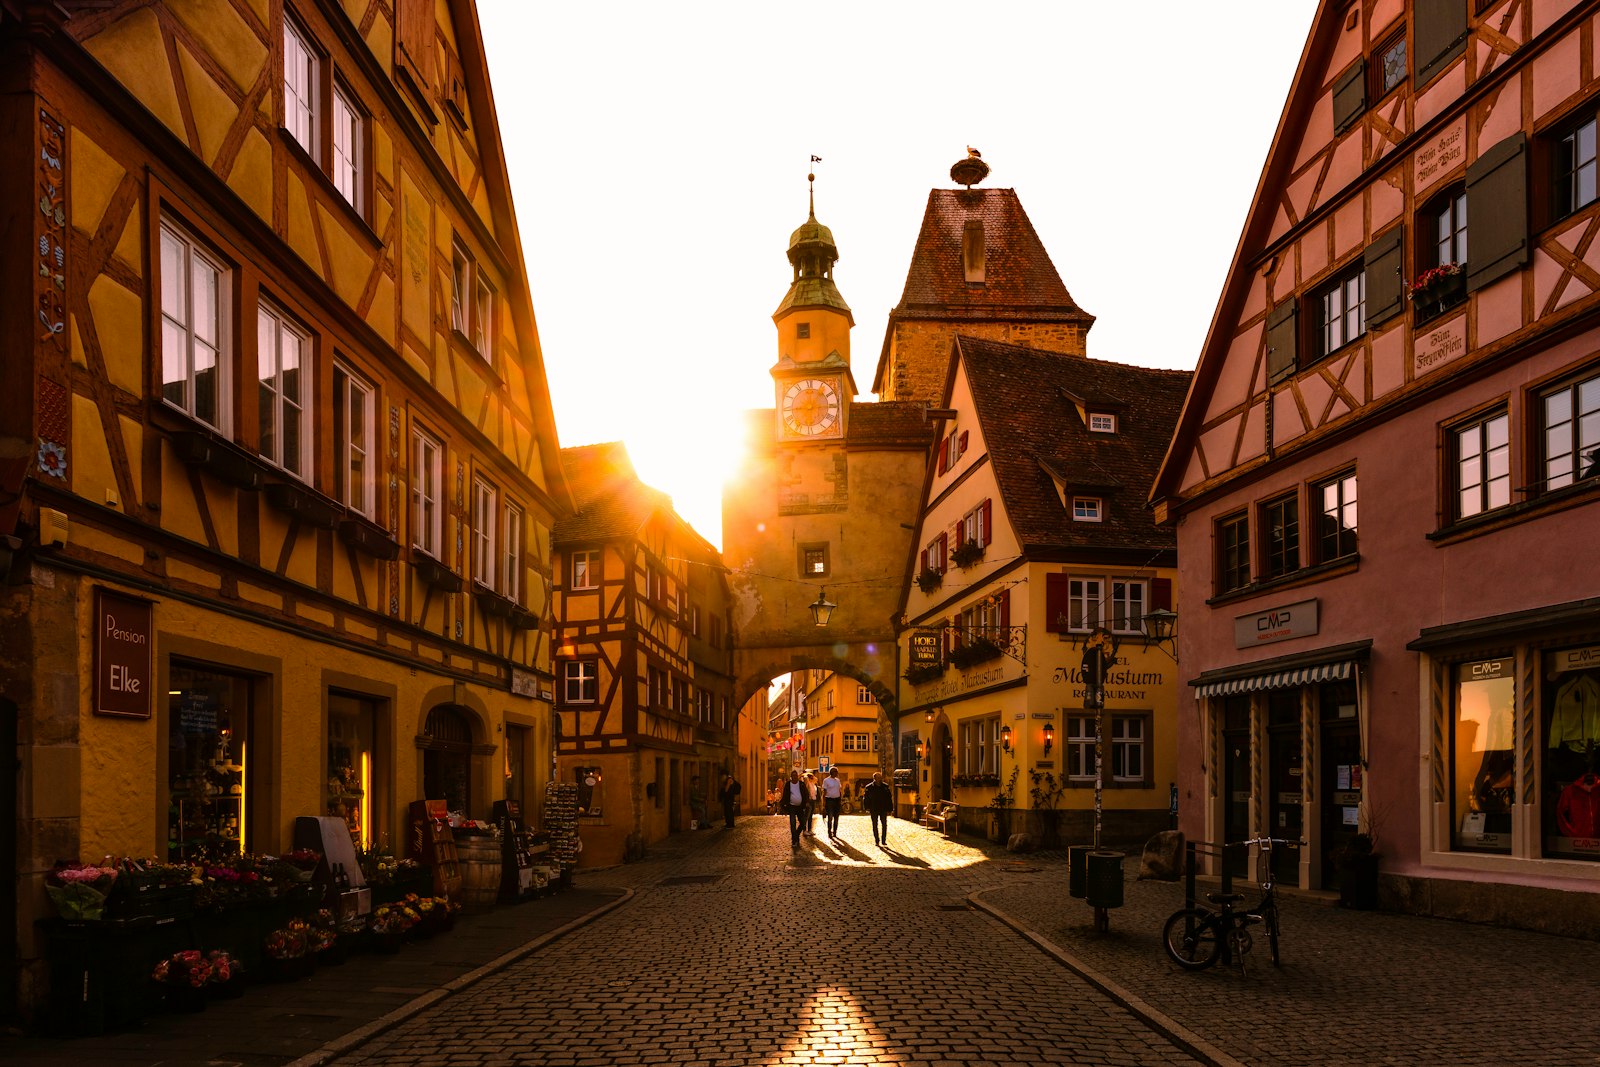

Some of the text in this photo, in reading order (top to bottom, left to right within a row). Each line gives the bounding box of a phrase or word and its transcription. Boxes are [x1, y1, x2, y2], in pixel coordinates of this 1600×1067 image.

[106, 614, 146, 644] Pension
[1257, 612, 1291, 631] CMP
[914, 636, 936, 646] HOTEL
[110, 663, 141, 693] Elke
[1472, 662, 1501, 675] CMP
